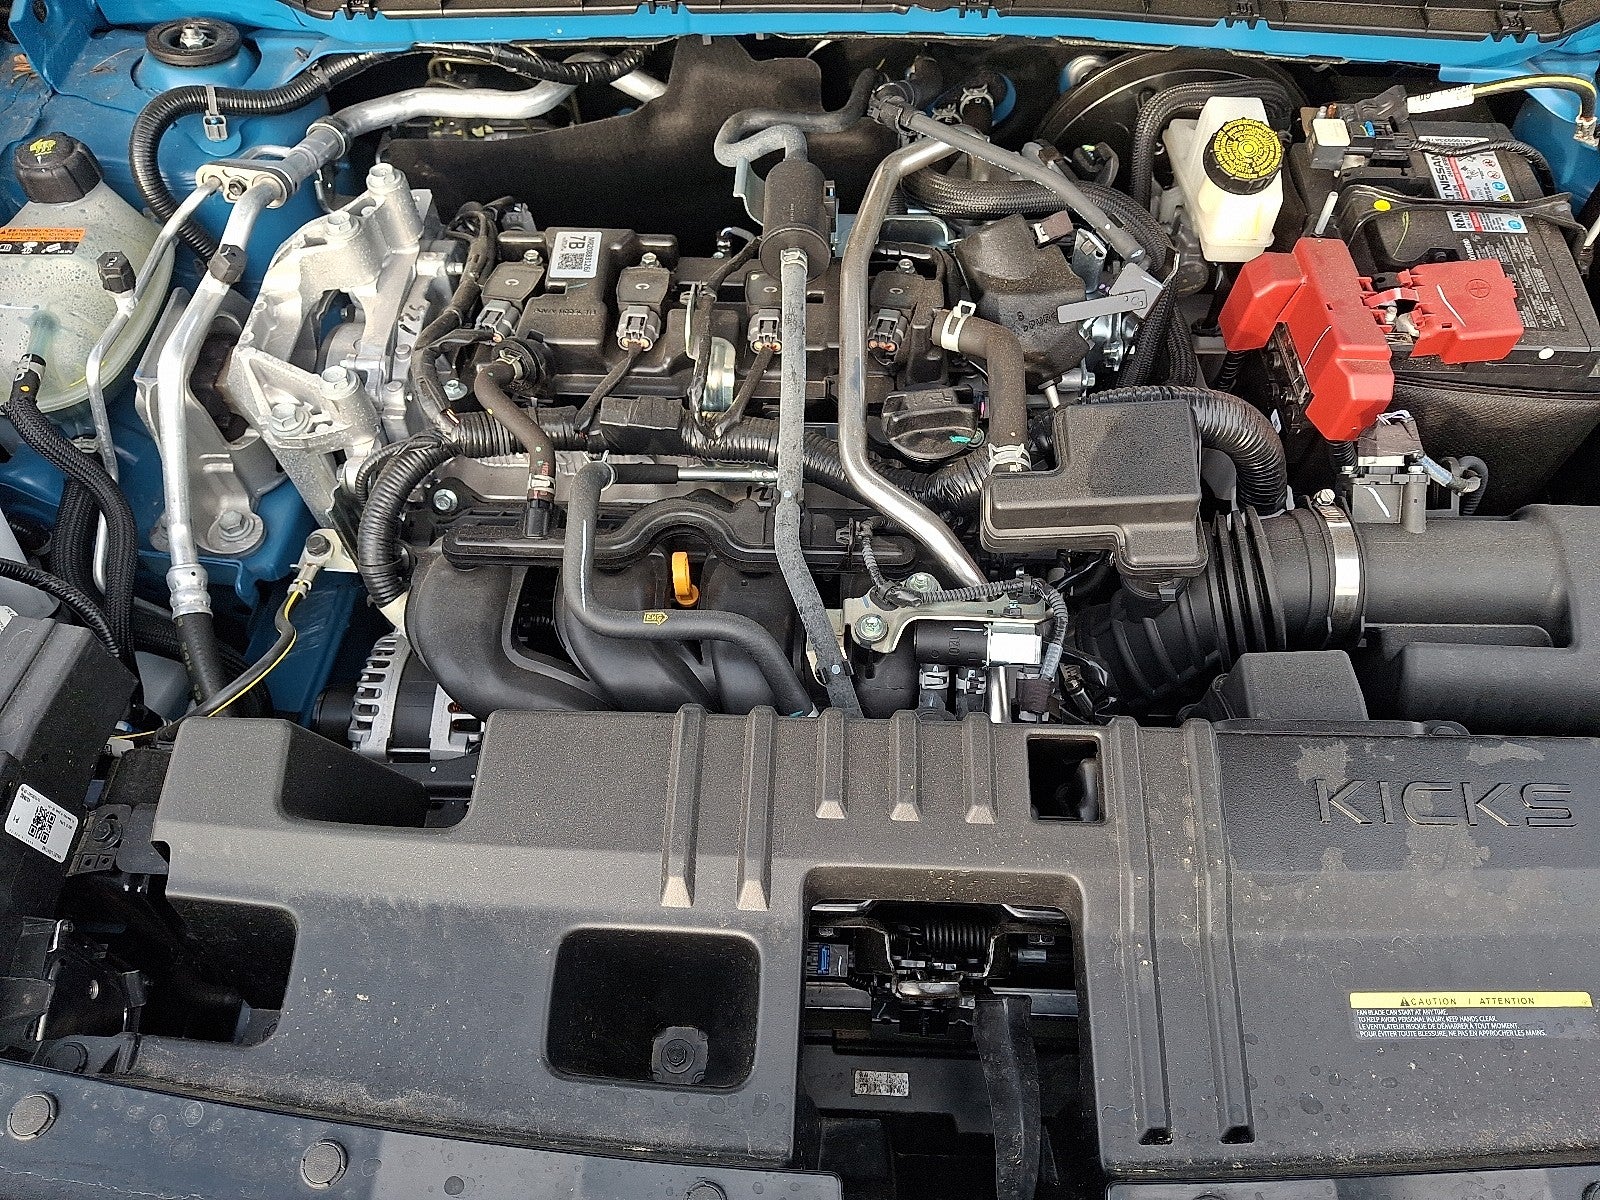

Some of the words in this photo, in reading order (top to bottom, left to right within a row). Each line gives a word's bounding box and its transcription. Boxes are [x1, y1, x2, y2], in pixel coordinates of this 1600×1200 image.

[568, 235, 587, 250] 7B
[1315, 779, 1578, 828] KICKS
[1411, 997, 1457, 1006] CAUTION
[1480, 997, 1535, 1005] ATTENTION
[1474, 1022, 1490, 1030] TOUT
[1478, 1029, 1514, 1037] APPROCHER
[1514, 1029, 1525, 1037] LES
